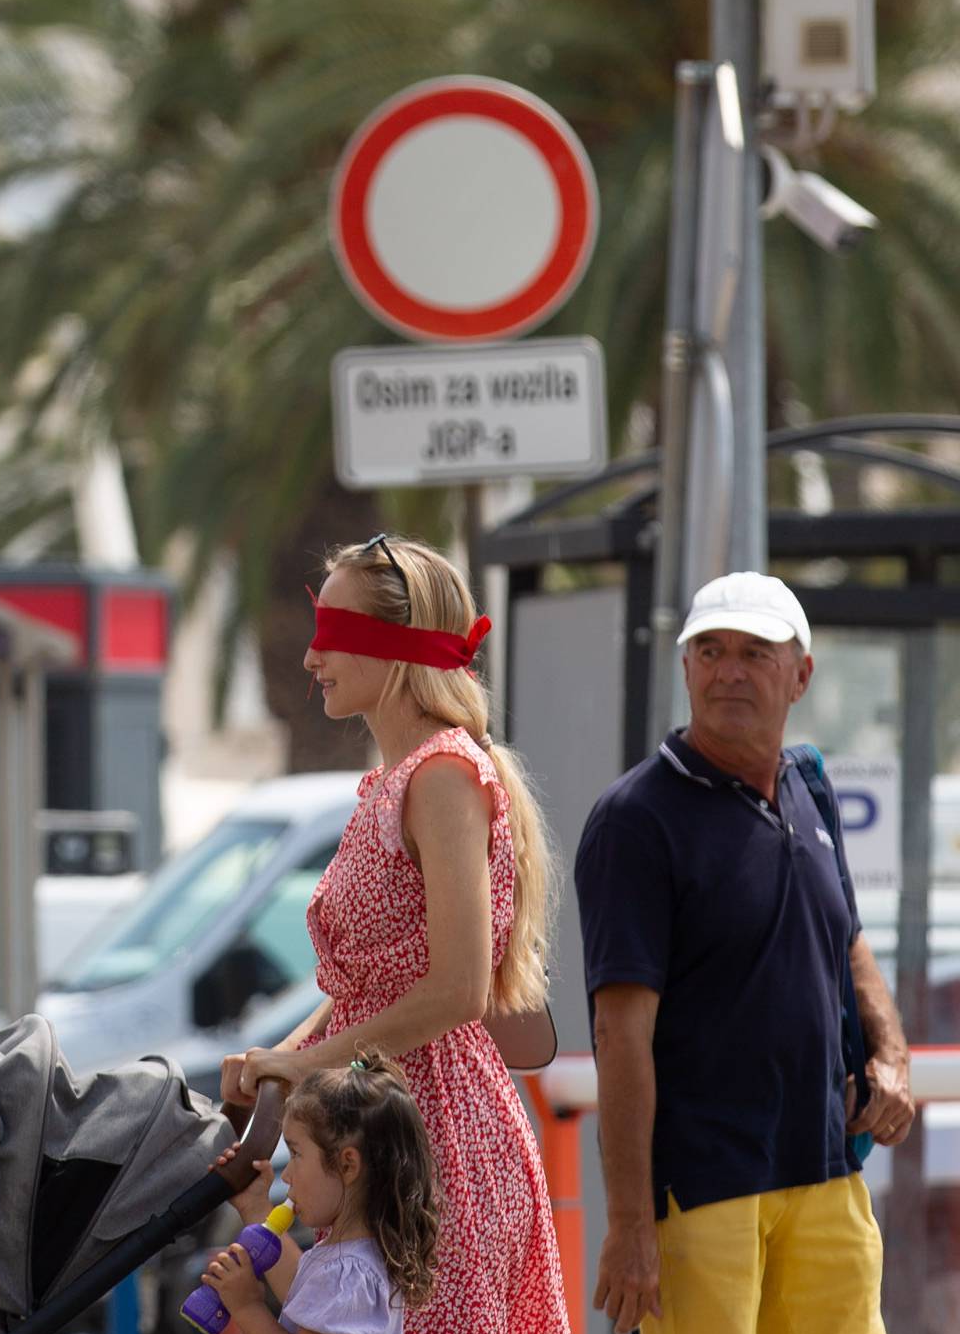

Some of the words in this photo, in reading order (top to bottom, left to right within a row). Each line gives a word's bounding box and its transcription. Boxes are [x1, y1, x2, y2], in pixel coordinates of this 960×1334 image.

[356, 369, 435, 411] Osim
[444, 374, 480, 405] za
[487, 365, 578, 405] vozila
[422, 422, 516, 461] JGP-a
